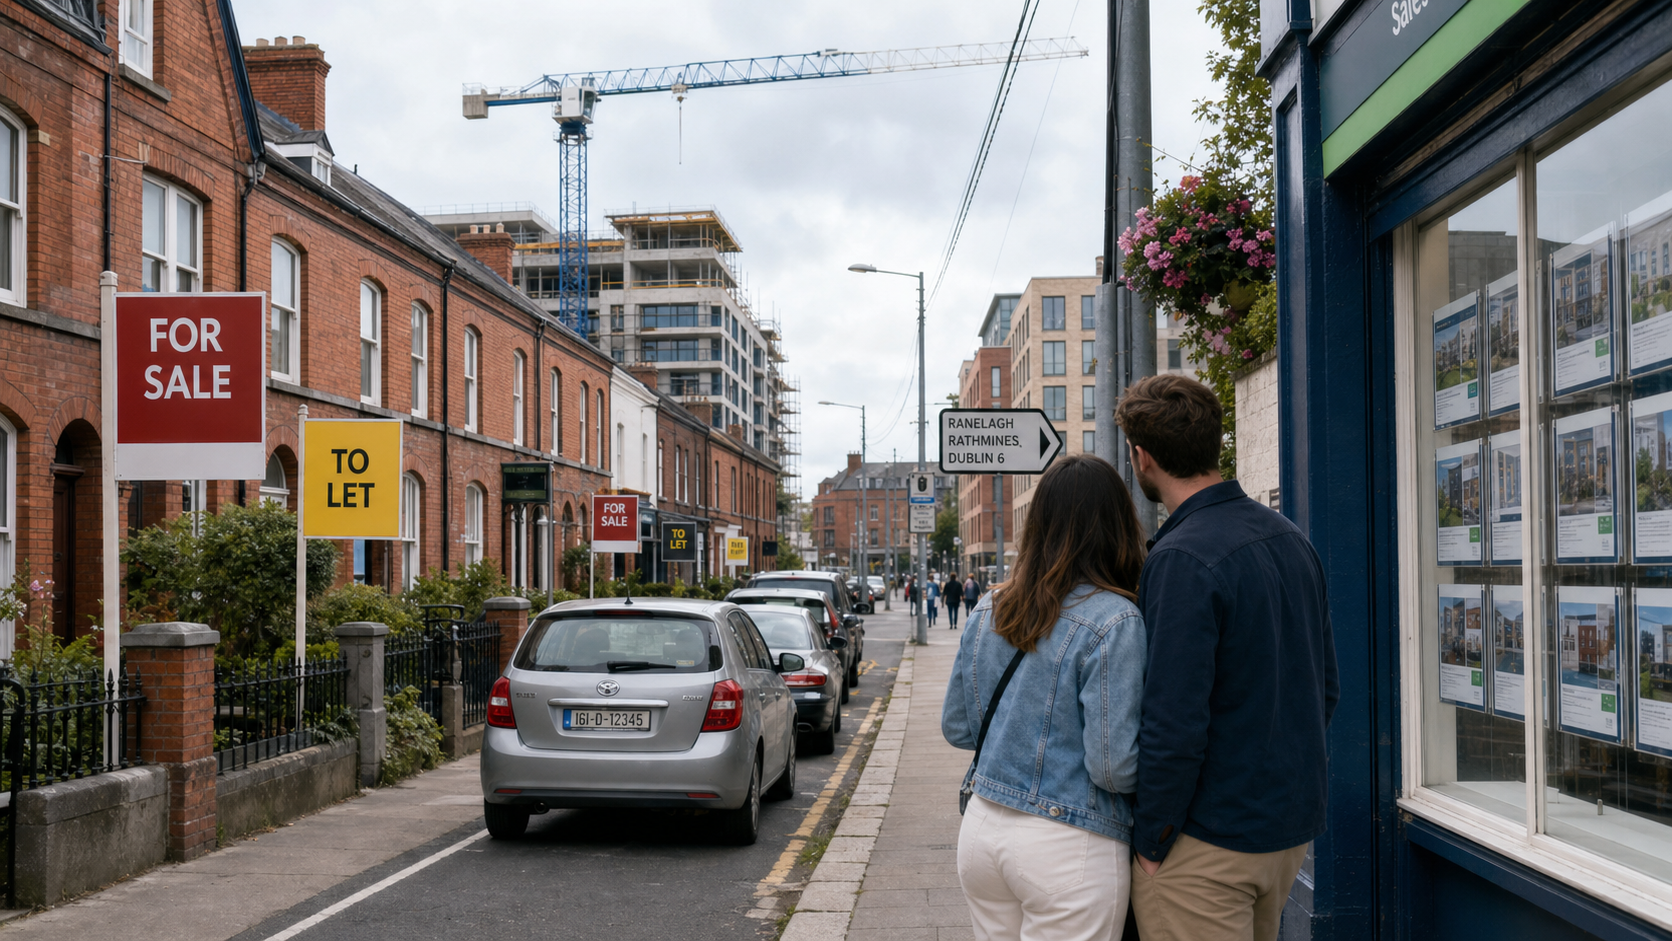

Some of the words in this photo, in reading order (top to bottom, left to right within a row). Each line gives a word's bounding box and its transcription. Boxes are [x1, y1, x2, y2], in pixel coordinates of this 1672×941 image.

[149, 317, 223, 353] FOR
[143, 364, 232, 400] SALE
[948, 417, 1014, 429] RANELAGH
[331, 448, 370, 474] TO
[948, 452, 993, 464] DUBLIN
[997, 452, 1005, 464] 6
[327, 482, 376, 508] LET
[603, 502, 626, 514] FOR
[601, 516, 628, 527] SALE
[671, 528, 686, 539] TO
[669, 539, 688, 550] LET
[575, 712, 643, 726] 161-D-12345
